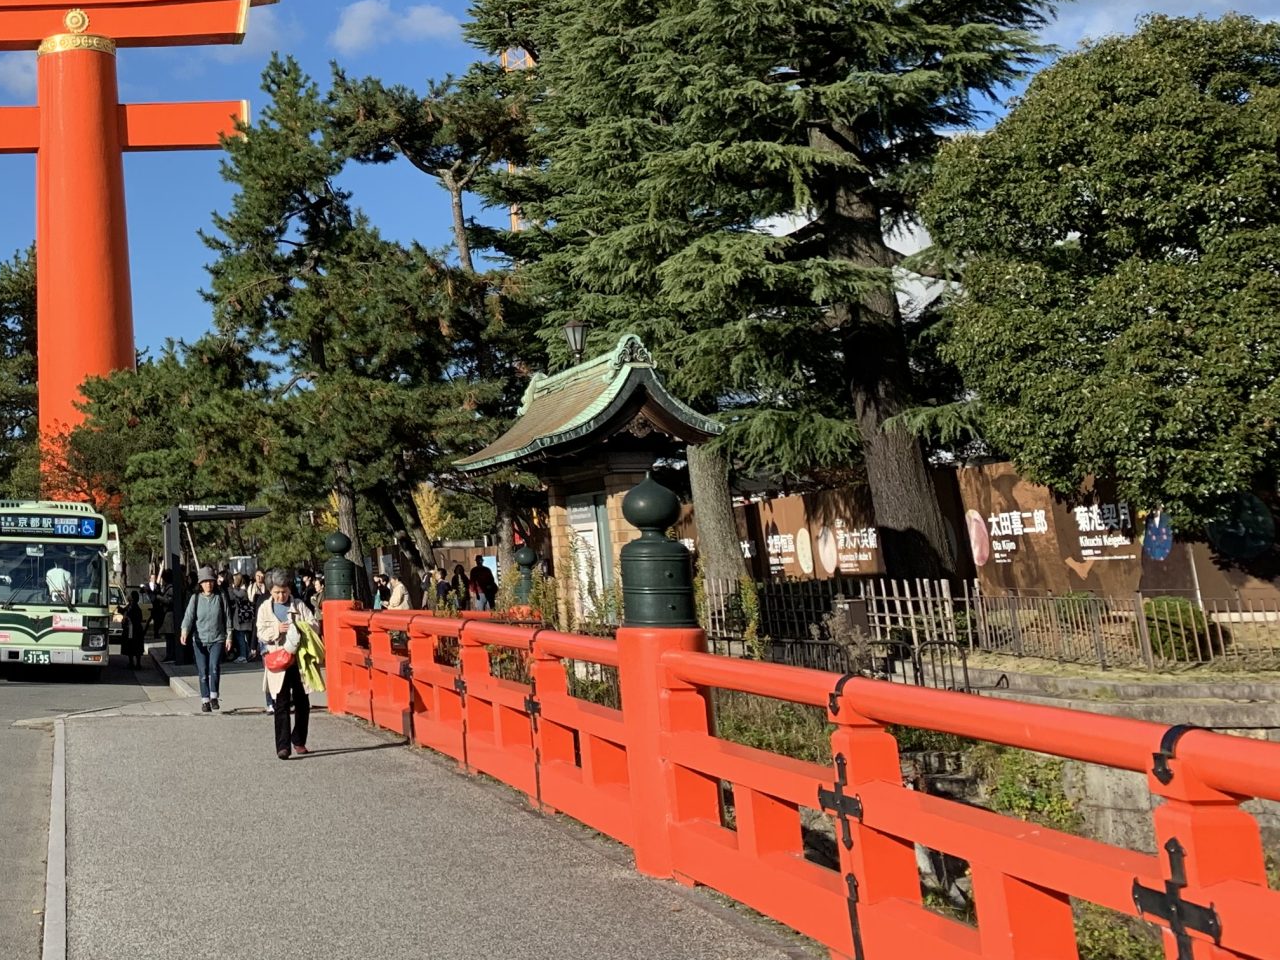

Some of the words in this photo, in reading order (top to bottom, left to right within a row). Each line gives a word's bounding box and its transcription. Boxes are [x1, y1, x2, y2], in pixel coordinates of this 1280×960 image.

[18, 517, 52, 527] 京都駅
[1074, 503, 1131, 531] 菊池契月
[988, 510, 1048, 537] 太田喜二郎
[56, 524, 76, 534] 100
[28, 654, 49, 663] 31-95
